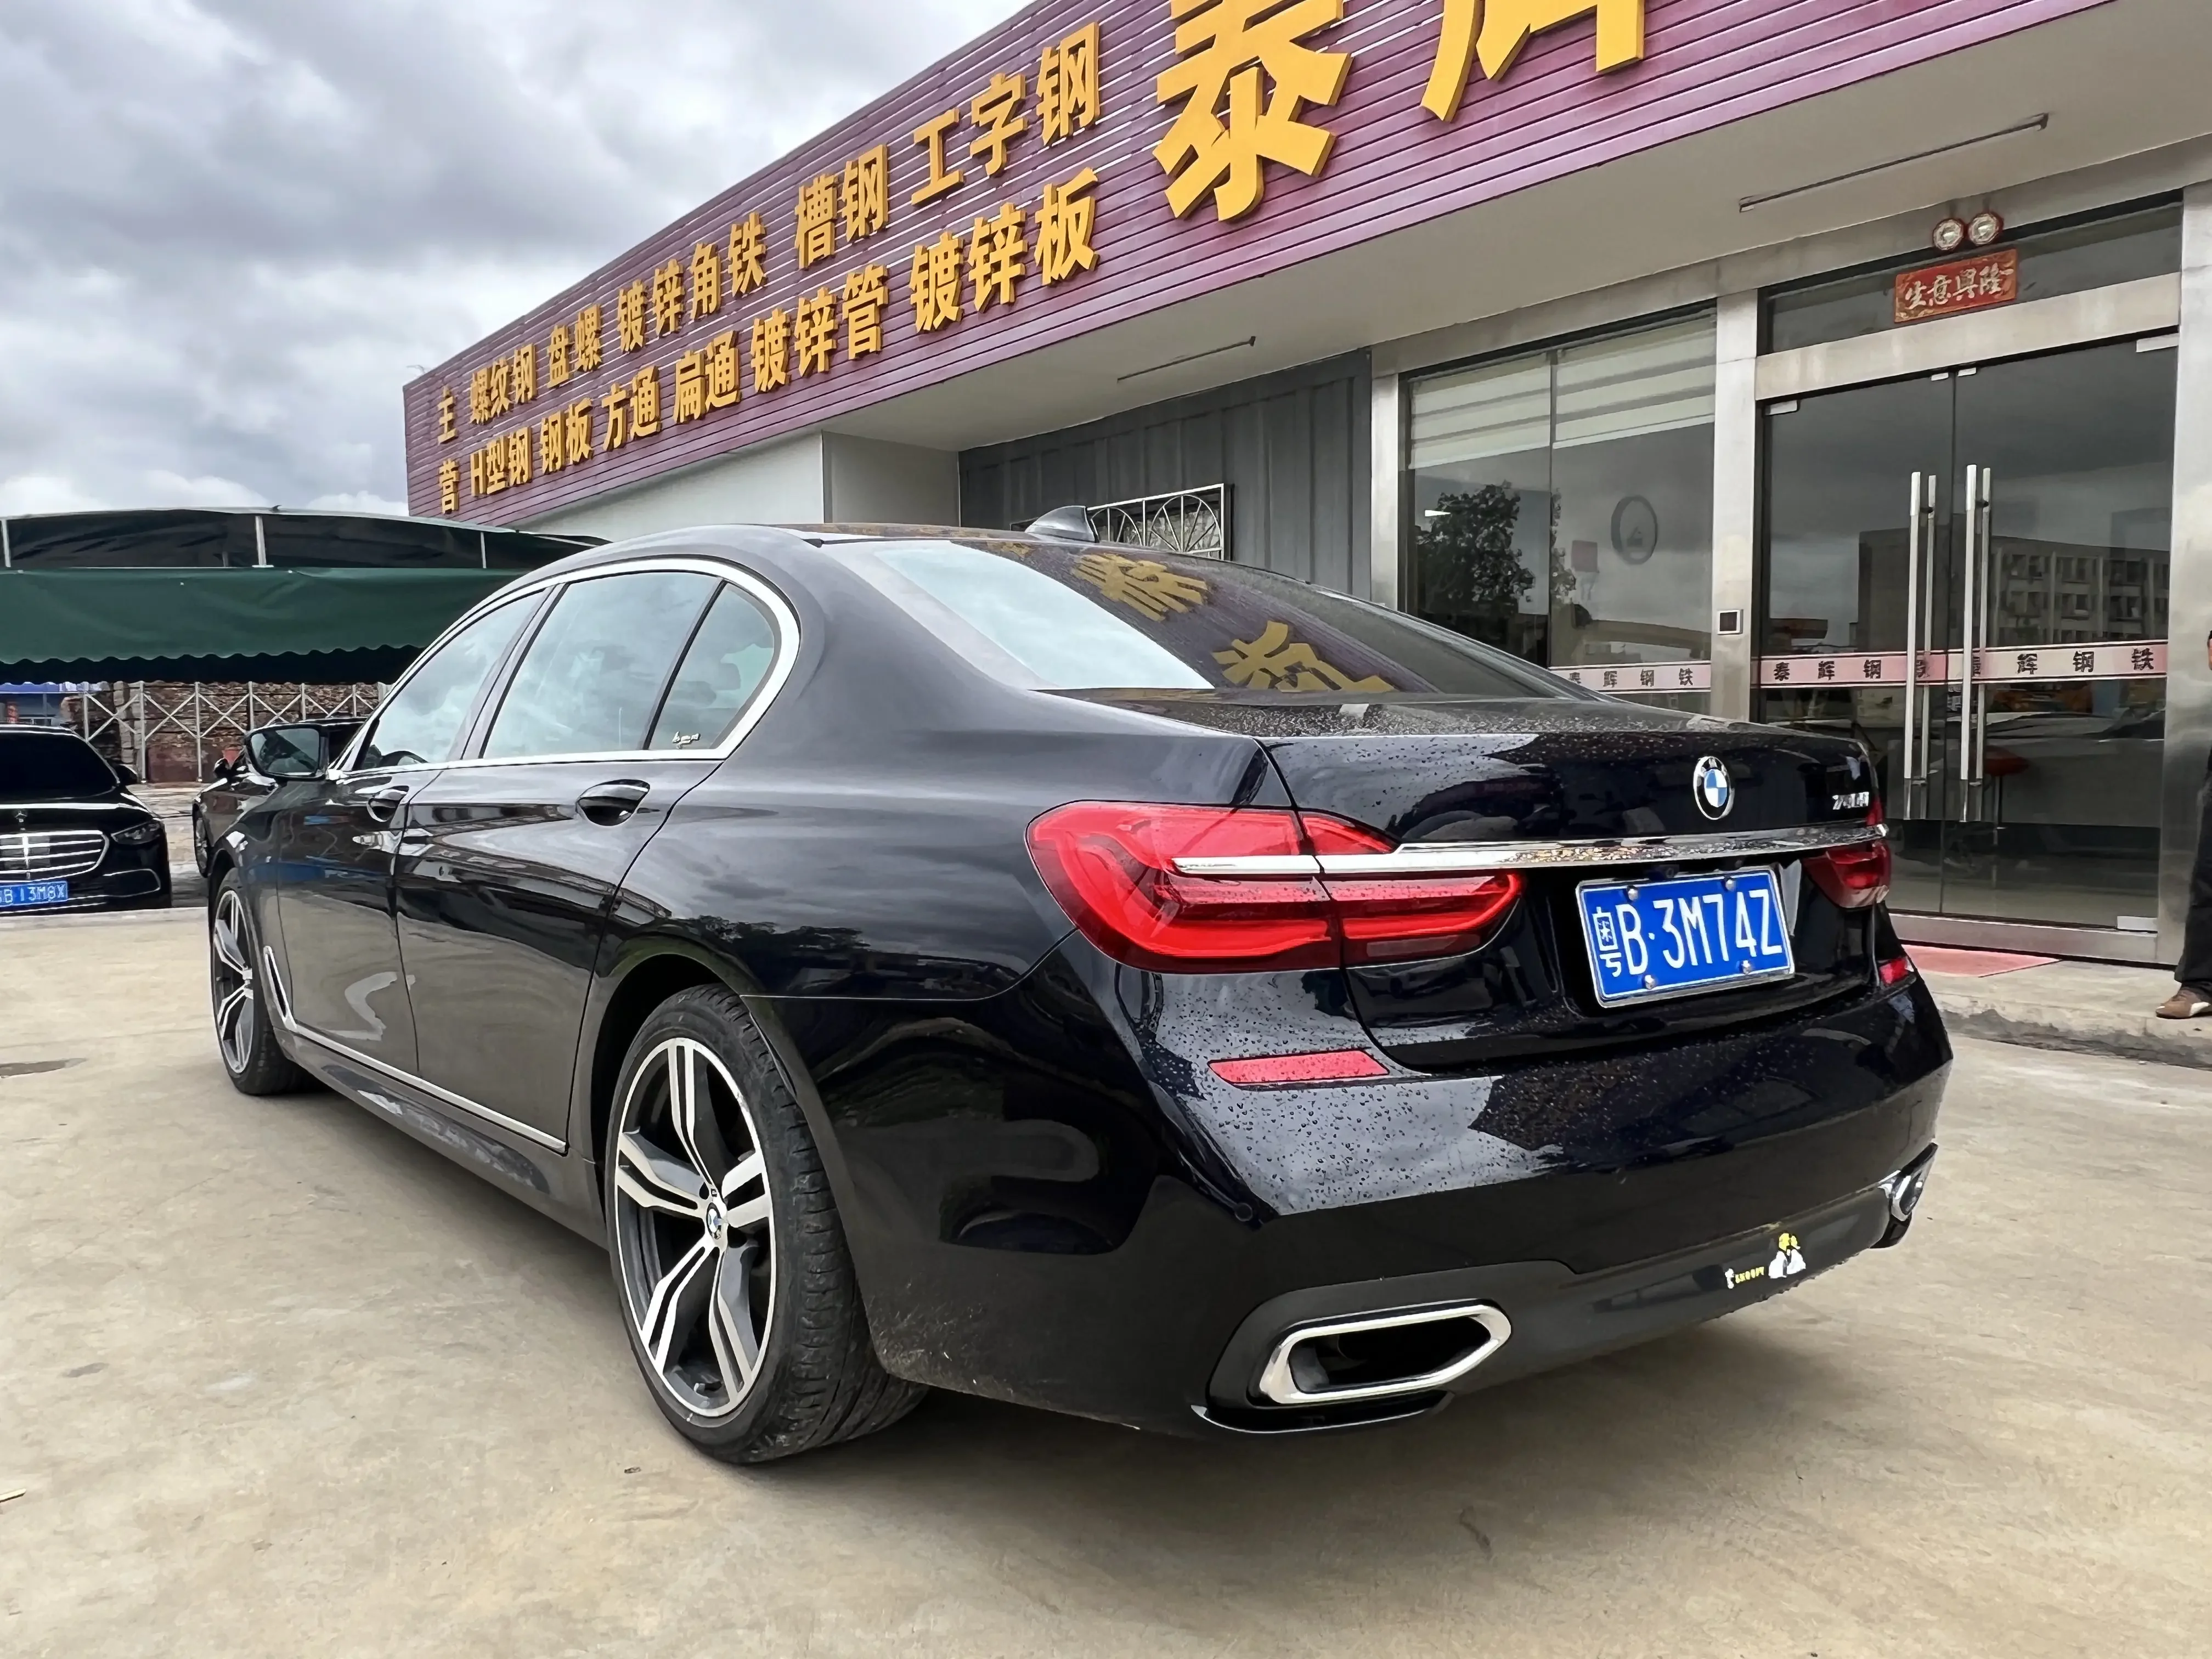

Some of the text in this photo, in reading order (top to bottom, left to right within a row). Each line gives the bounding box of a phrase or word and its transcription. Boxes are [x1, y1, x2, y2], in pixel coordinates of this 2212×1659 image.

[470, 22, 1101, 425] 螺纹钢 盘螺 镀锌角铁 槽钢 工字钢
[470, 167, 1099, 497] H型钢 钢板 方通 扁通 镀锌管 镀锌板
